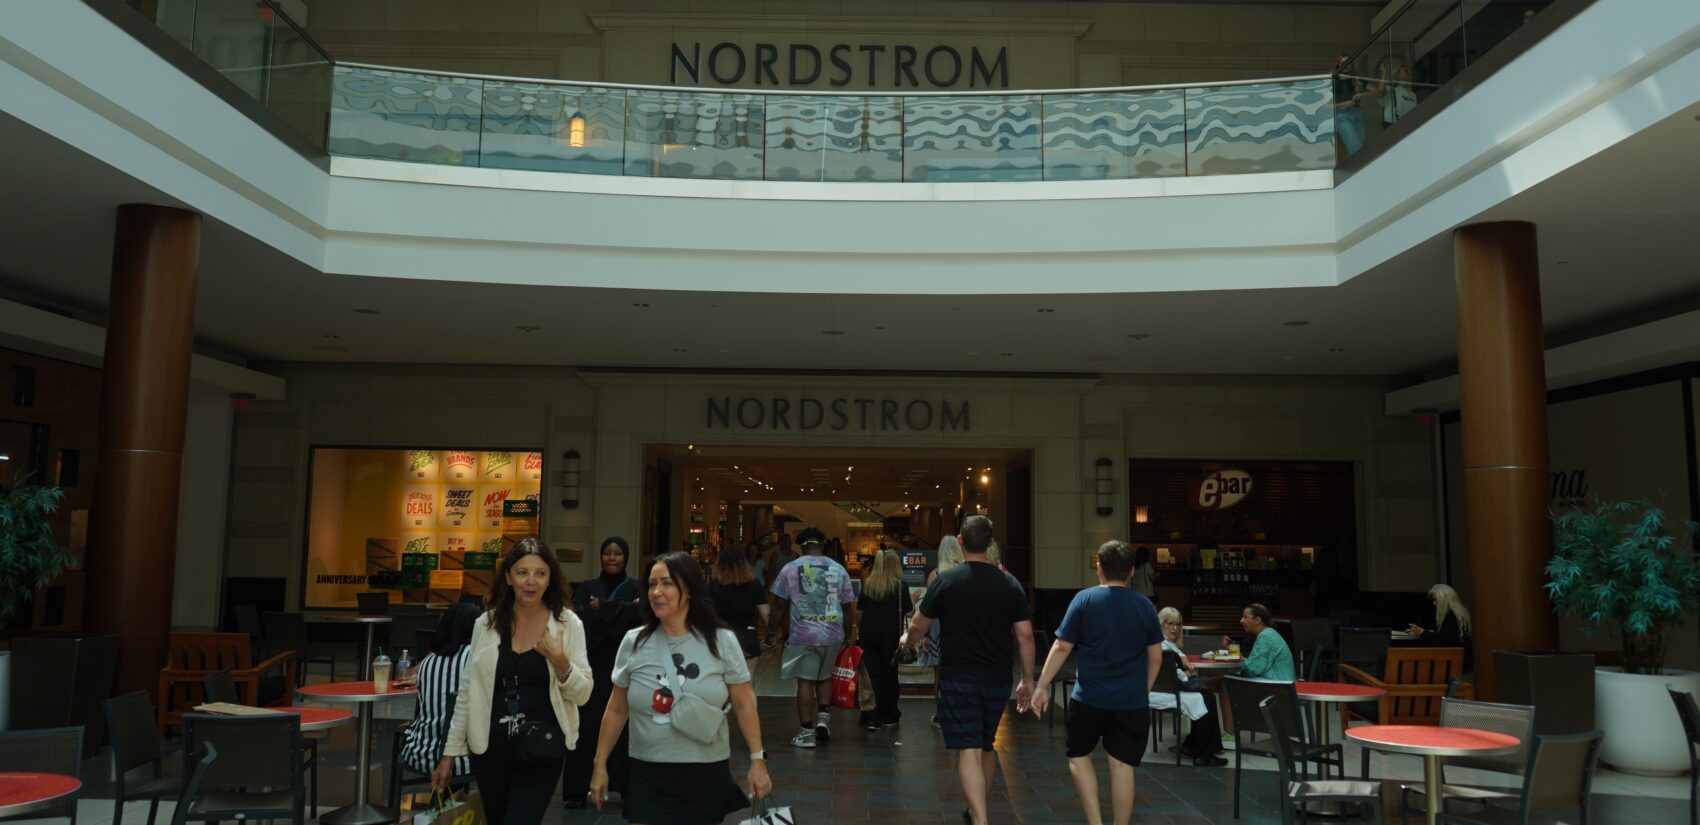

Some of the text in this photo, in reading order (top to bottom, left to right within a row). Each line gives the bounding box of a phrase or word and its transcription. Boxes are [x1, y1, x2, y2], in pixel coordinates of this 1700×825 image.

[670, 42, 1009, 87] NORDSTROM
[707, 398, 971, 431] NORDSTROM
[447, 454, 475, 465] BRANDS
[446, 490, 473, 499] SWEET
[484, 489, 511, 506] NOW
[407, 502, 433, 514] DEALS
[445, 499, 470, 507] DEALS
[903, 555, 927, 565] EBAR
[316, 575, 367, 584] ANNIVERSARY
